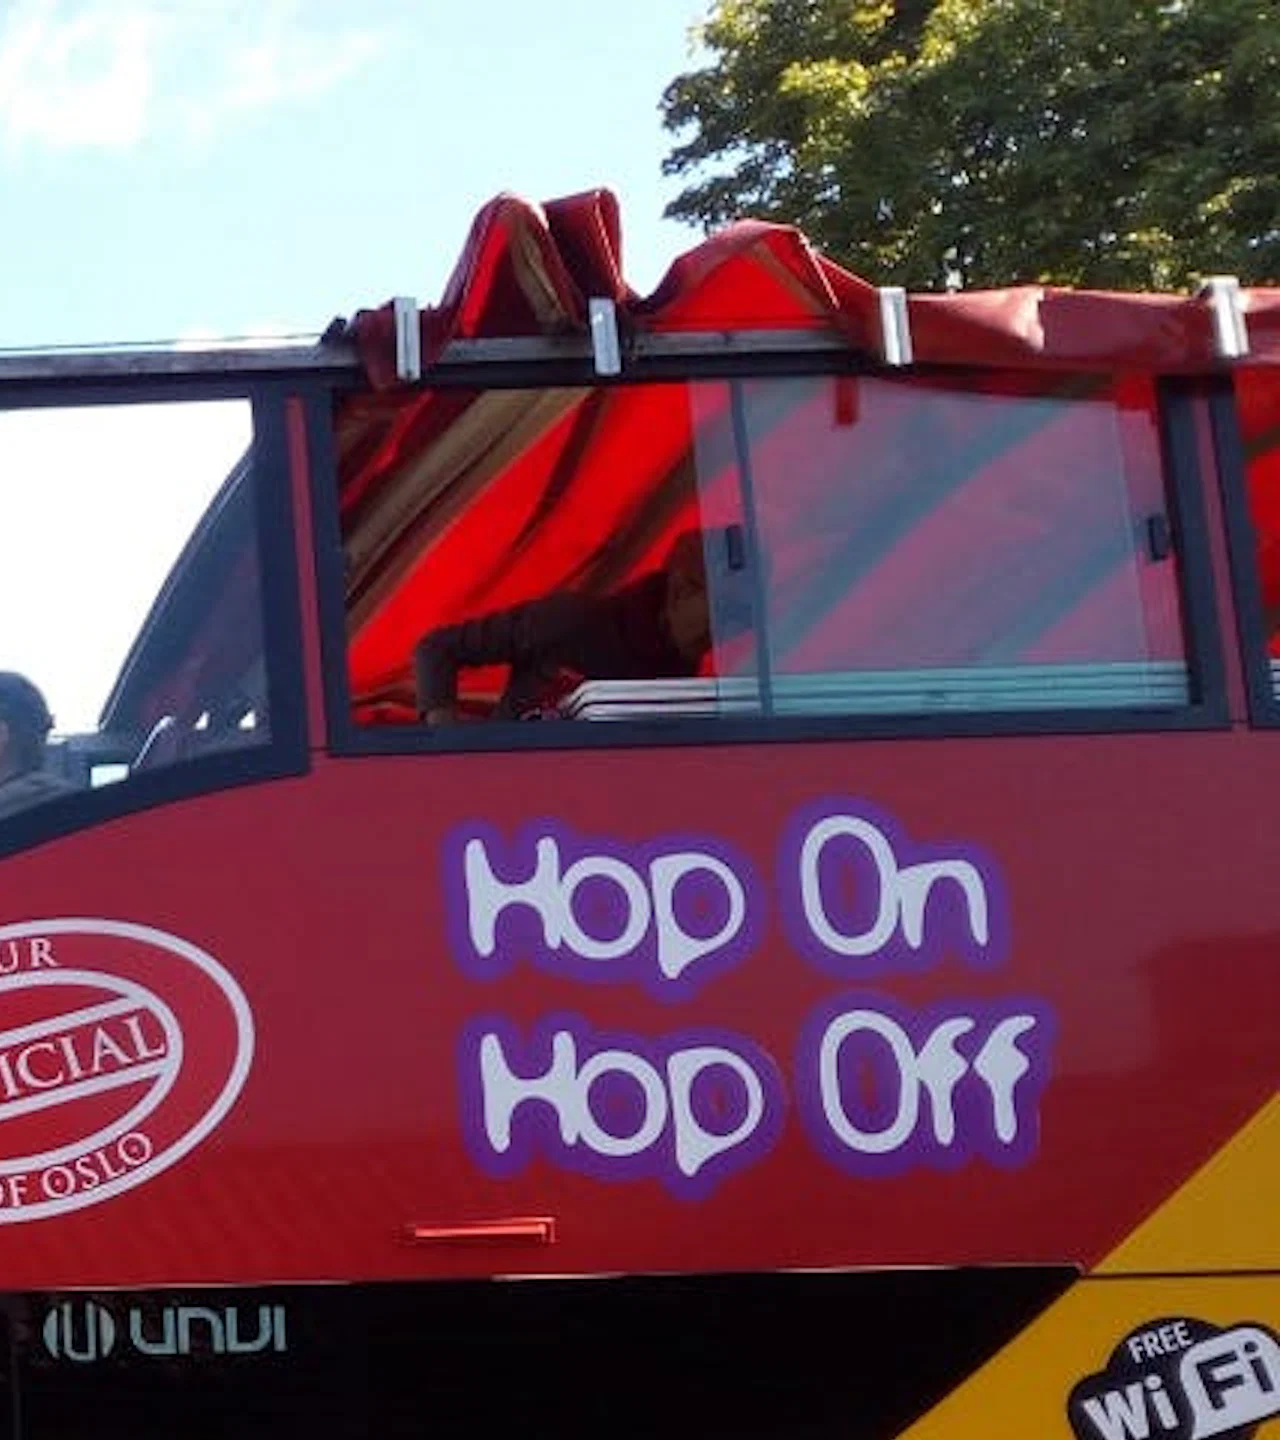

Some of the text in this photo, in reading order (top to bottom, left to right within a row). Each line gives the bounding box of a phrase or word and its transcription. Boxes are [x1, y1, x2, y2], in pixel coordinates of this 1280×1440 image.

[465, 815, 988, 979] Hop On
[480, 1010, 1036, 1176] Hop Off
[42, 1131, 153, 1199] OSLO
[1127, 1320, 1192, 1364] FREE
